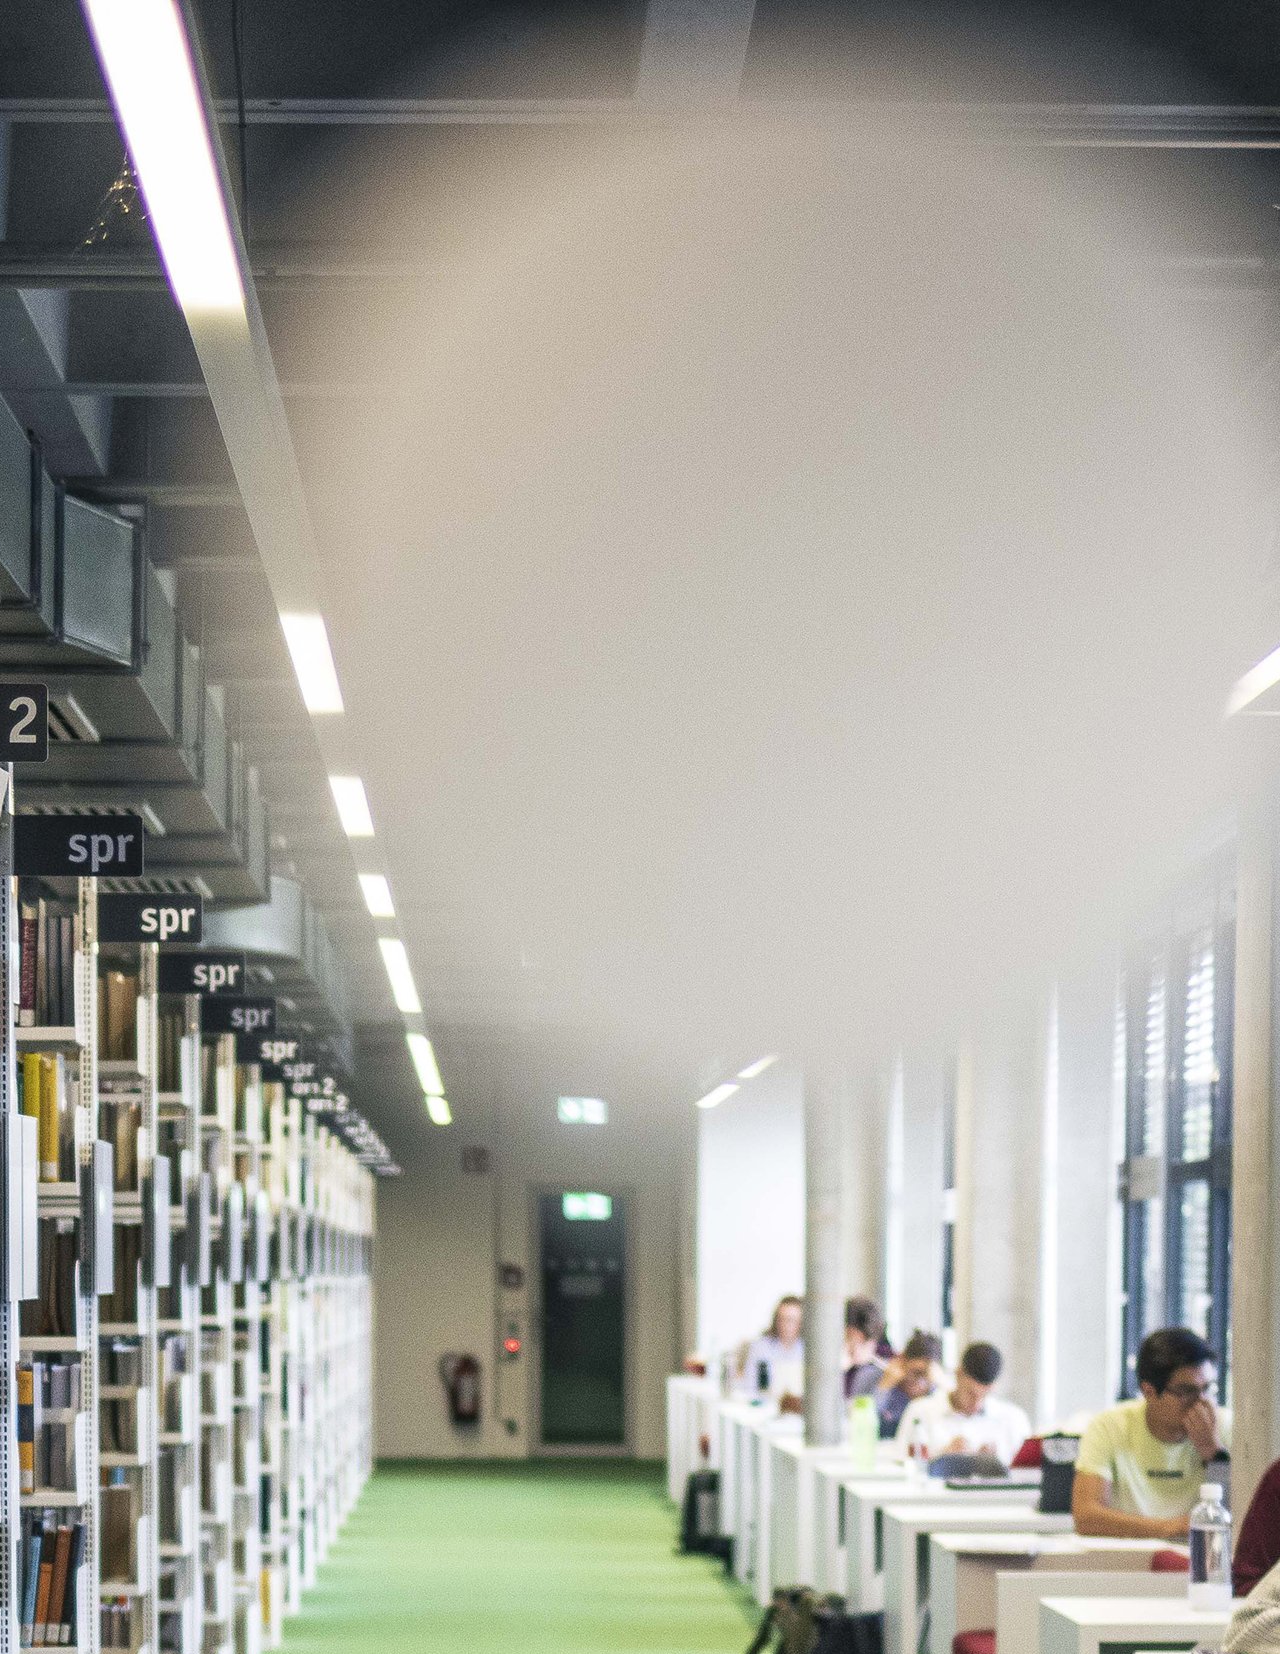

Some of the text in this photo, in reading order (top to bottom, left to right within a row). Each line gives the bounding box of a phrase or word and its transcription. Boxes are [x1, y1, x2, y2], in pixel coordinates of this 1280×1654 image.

[9, 696, 37, 744] 2
[68, 833, 134, 873] spr
[140, 907, 196, 940] spr
[193, 963, 240, 992] spr
[230, 1007, 271, 1032] spr
[260, 1040, 298, 1064] spr
